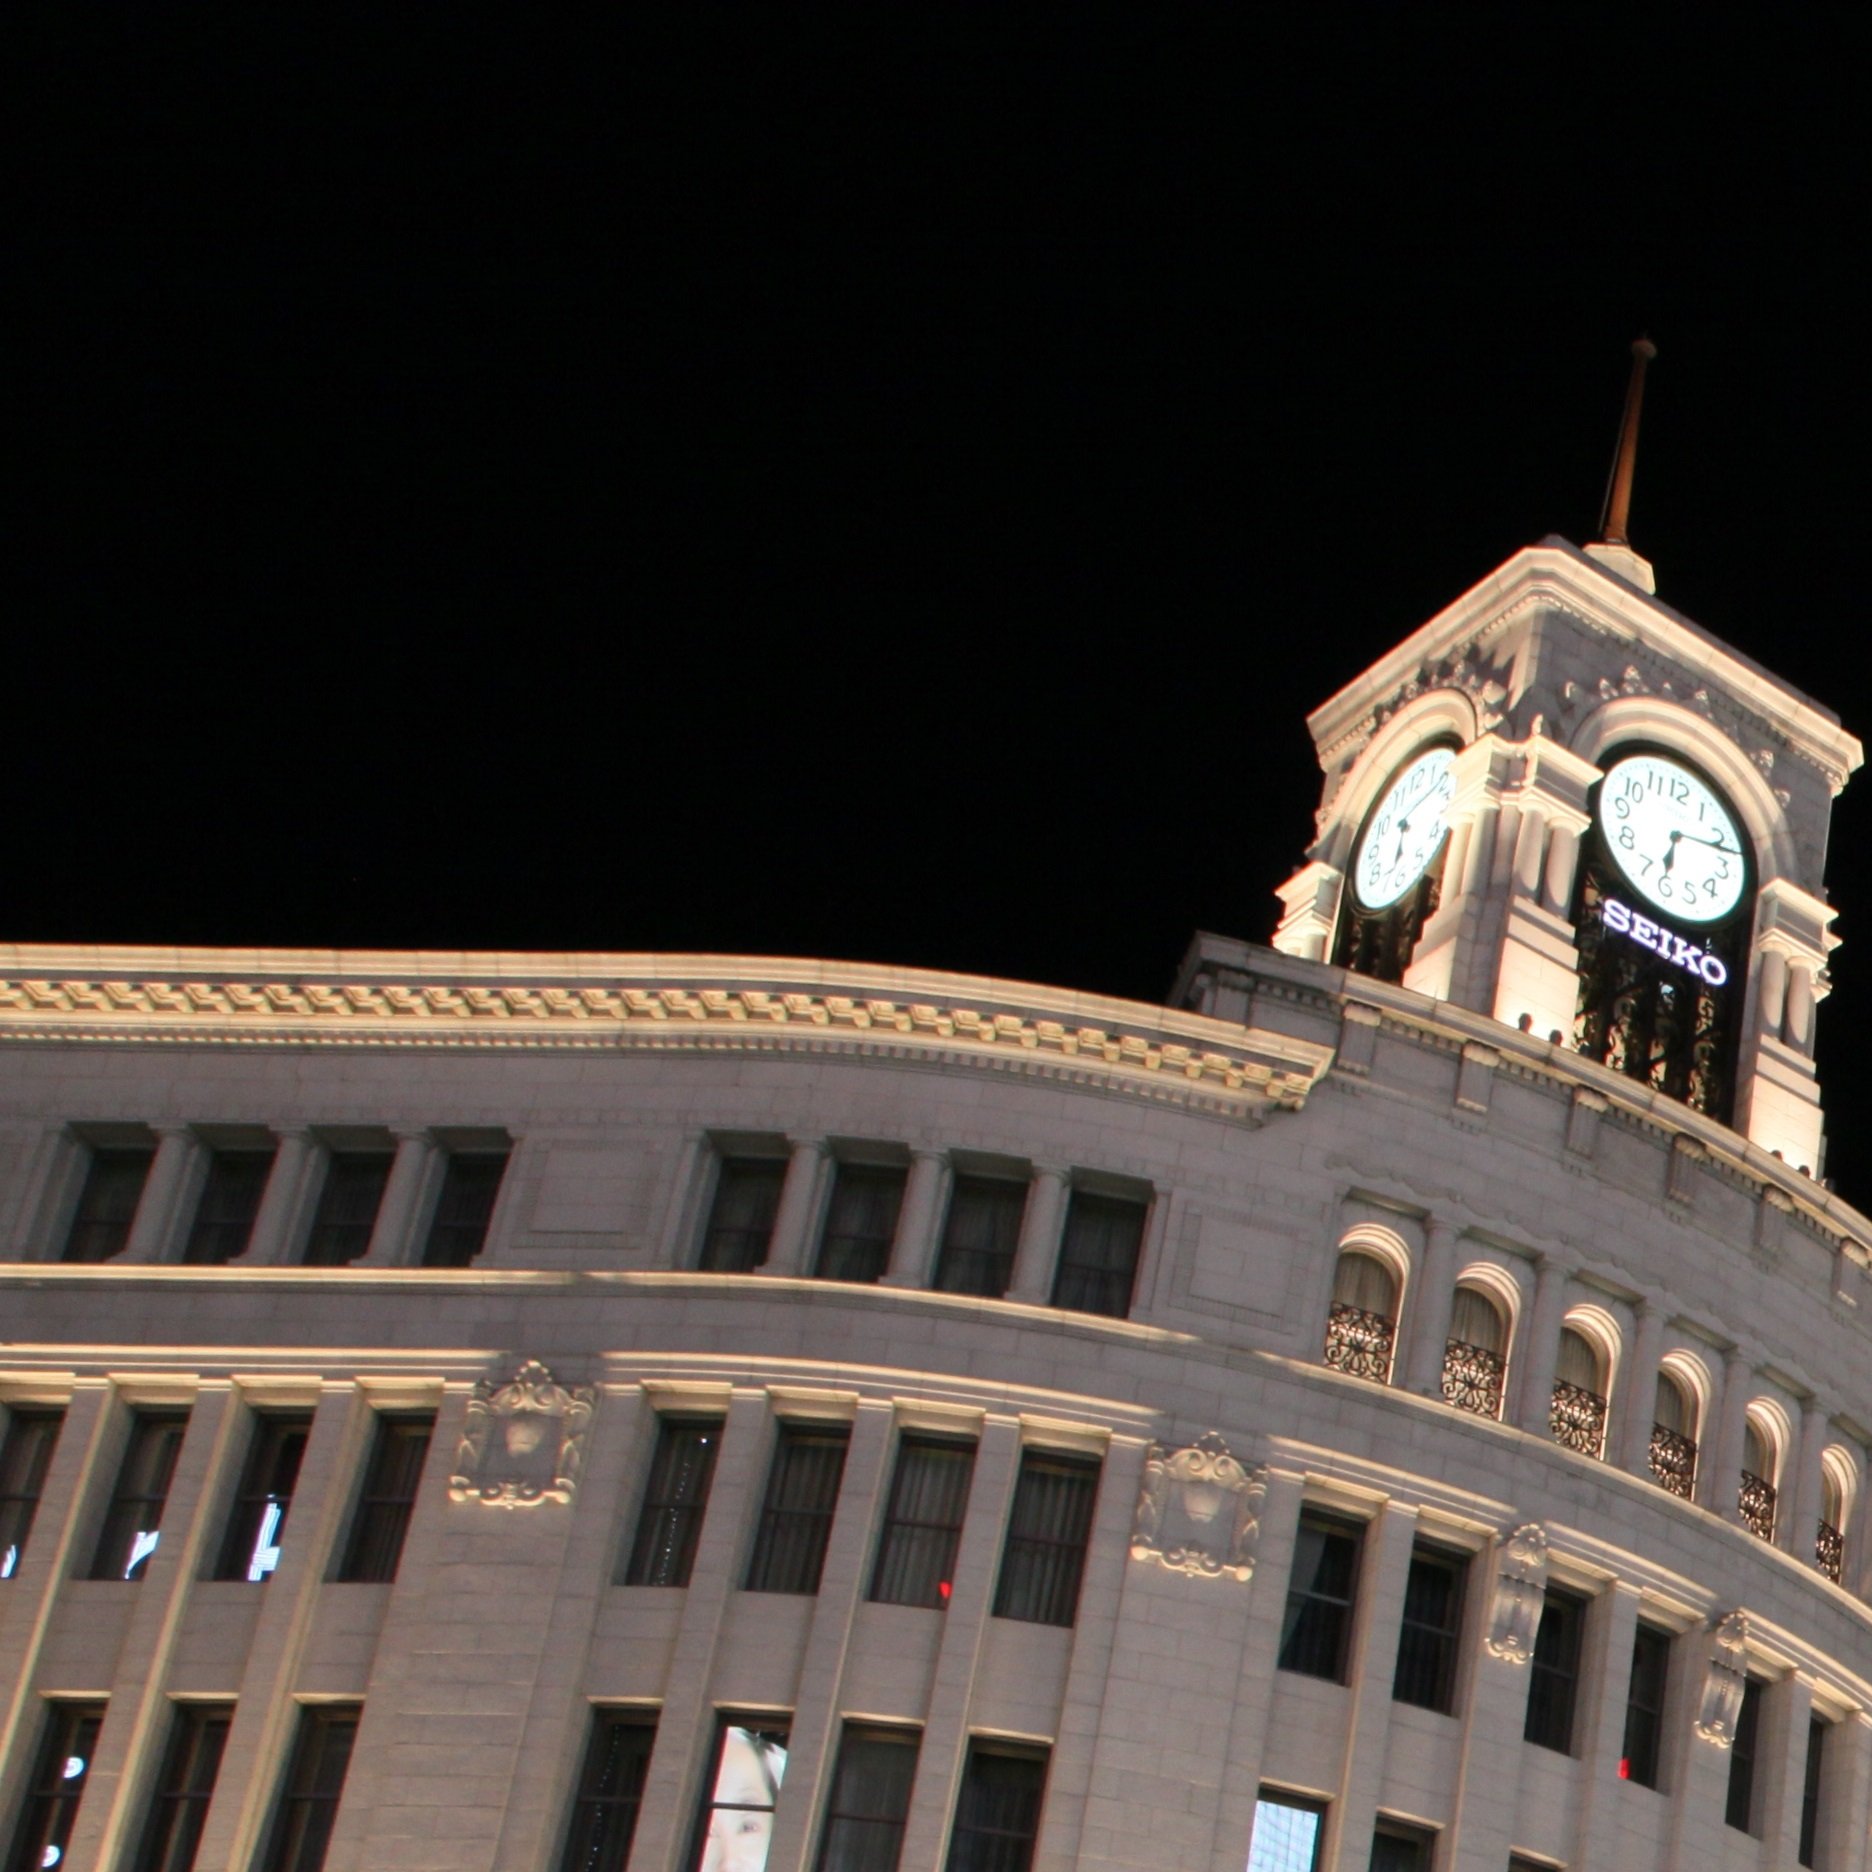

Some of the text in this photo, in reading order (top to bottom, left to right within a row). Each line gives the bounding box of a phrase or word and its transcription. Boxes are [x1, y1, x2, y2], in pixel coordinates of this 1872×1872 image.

[1625, 777, 1643, 802] 10
[1648, 771, 1663, 795] 11
[1670, 779, 1689, 805] 12
[1615, 798, 1629, 819] 9
[1619, 826, 1634, 850] 8
[1640, 854, 1653, 876] 7
[1716, 857, 1728, 879] 3
[1658, 875, 1672, 897] 6
[1683, 882, 1697, 904] 5
[1703, 878, 1718, 898] 4
[1603, 898, 1728, 987] SEIKO
